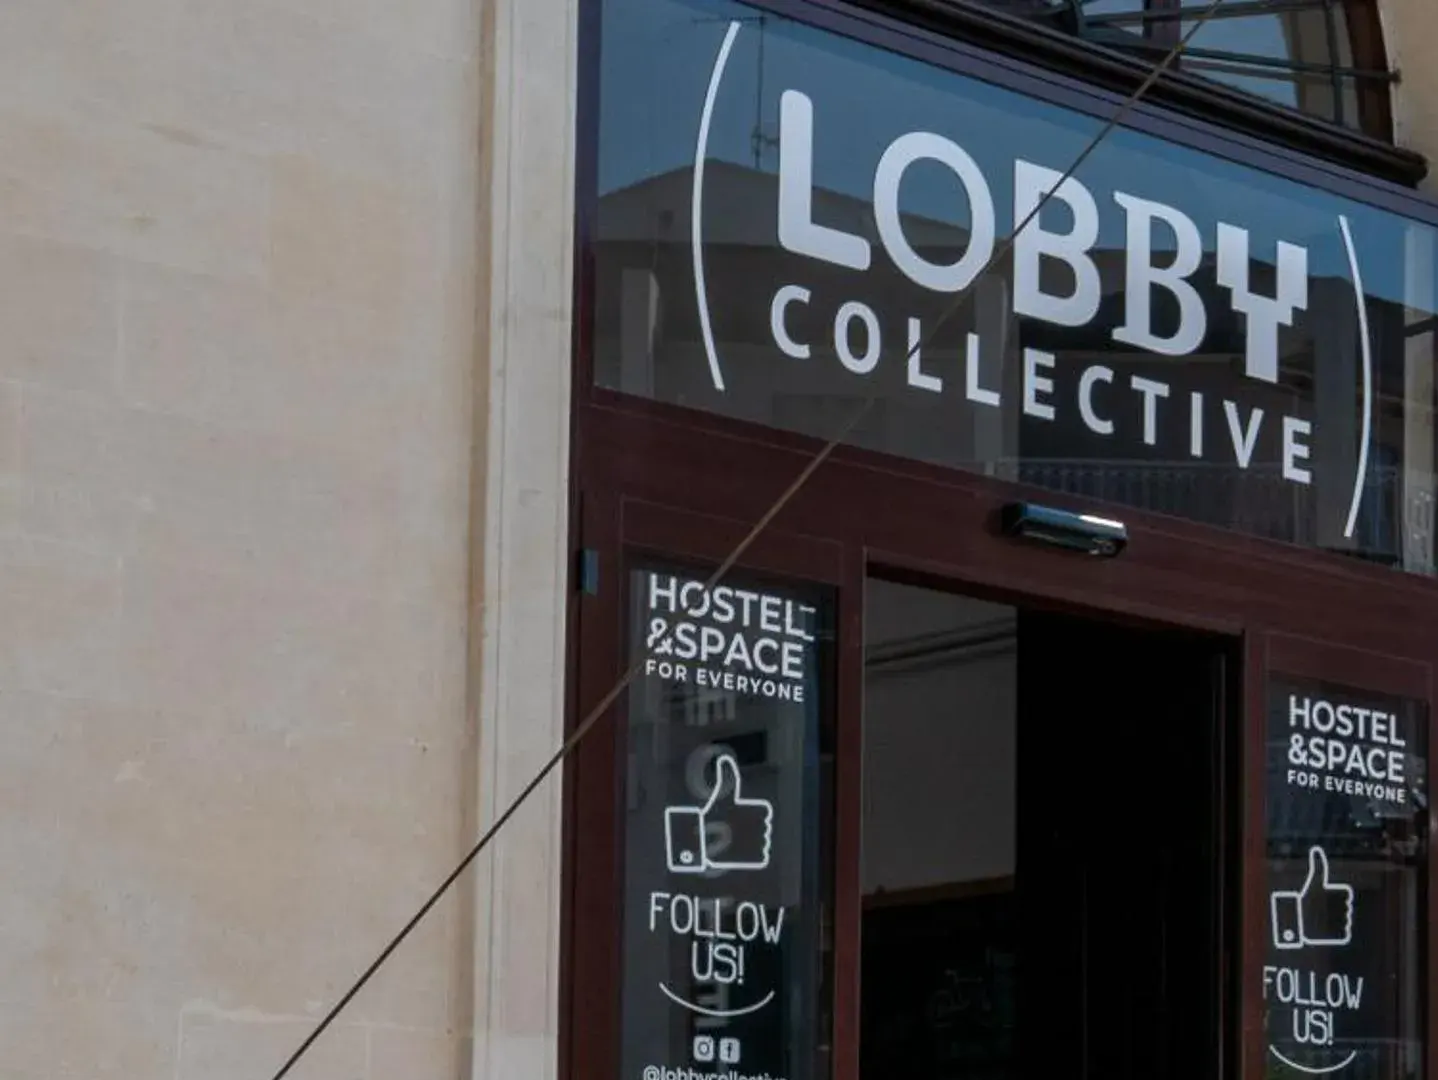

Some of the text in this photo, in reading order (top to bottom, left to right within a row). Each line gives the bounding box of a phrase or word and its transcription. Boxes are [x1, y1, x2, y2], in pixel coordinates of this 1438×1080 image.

[777, 88, 1309, 383] LOBBY
[769, 284, 1313, 485] COLLECTIVE
[650, 573, 816, 642] HOSTEL
[647, 617, 804, 679] &SPACE
[645, 659, 805, 703] FOR EVERYONE
[1289, 694, 1406, 747] HOSTEL
[1288, 733, 1405, 783] &SPACE
[1287, 769, 1407, 804] FOR EVERYONE
[650, 891, 785, 945] FOLLOW
[691, 940, 745, 985] US!
[1262, 965, 1364, 1010] FOLLOW
[1293, 1007, 1334, 1046] US!
